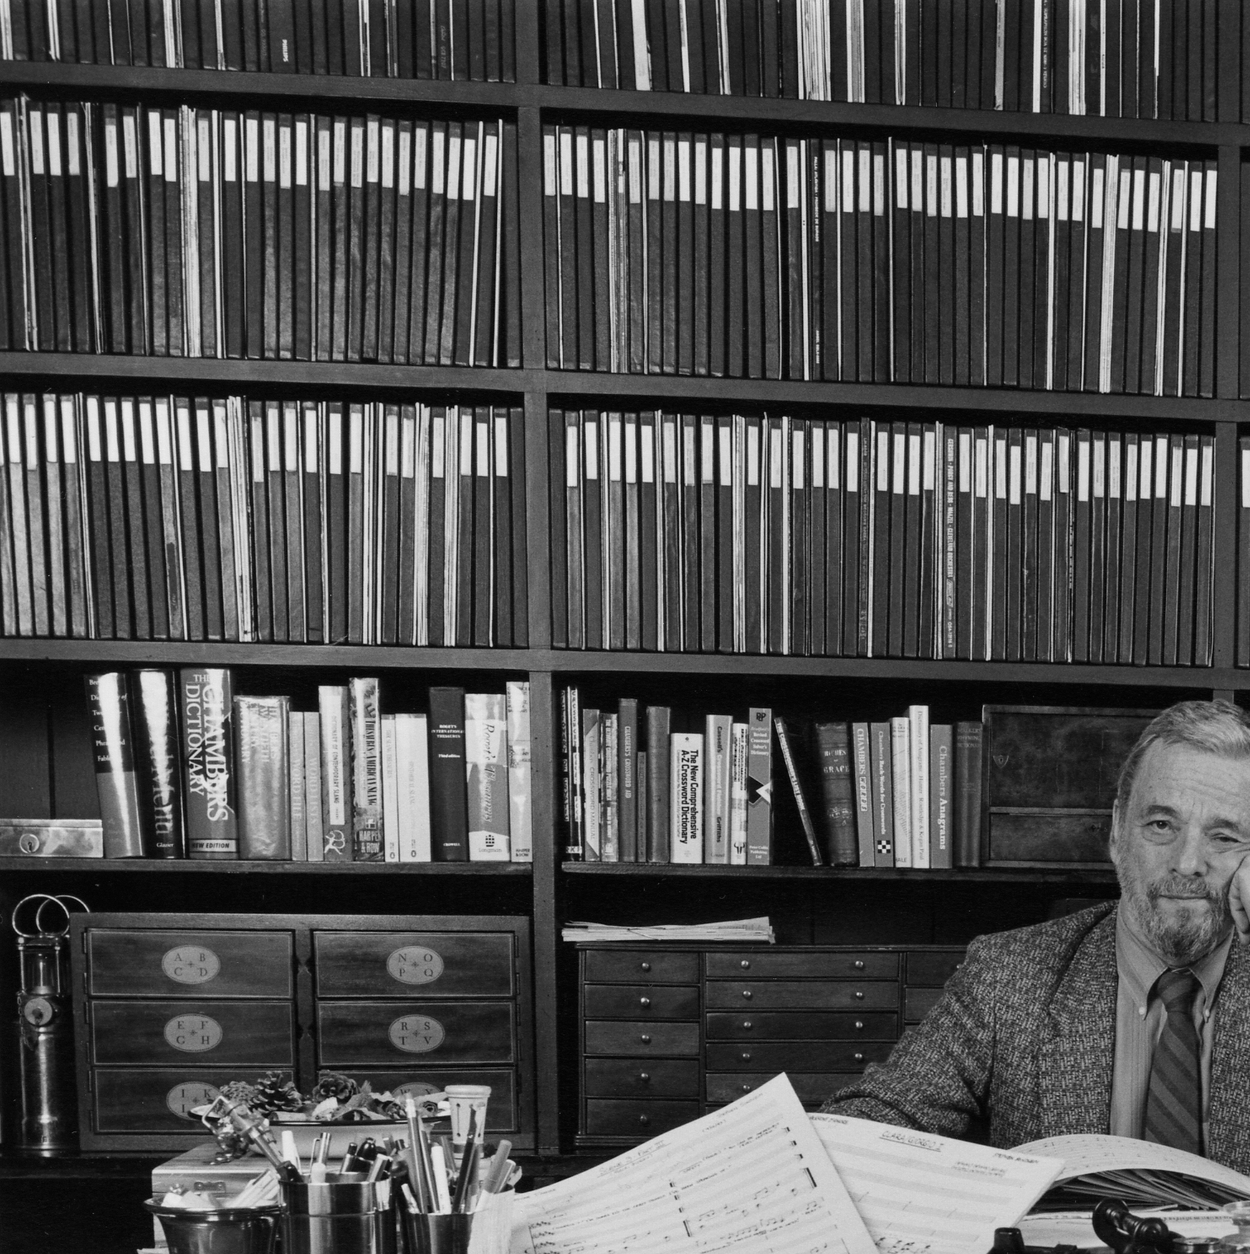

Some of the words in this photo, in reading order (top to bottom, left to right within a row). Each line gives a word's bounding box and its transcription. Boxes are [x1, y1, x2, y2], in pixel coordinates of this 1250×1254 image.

[184, 685, 205, 796] DICTIONARY
[201, 684, 229, 822] CHAMBERS
[483, 723, 496, 763] Roget's
[856, 728, 867, 775] CHAMBERS
[690, 750, 699, 763] The
[293, 758, 302, 789] WORD
[309, 757, 318, 791] WORD
[366, 755, 378, 786] AMERICAN
[624, 758, 632, 787] CROSSWORD
[690, 765, 699, 782] New
[938, 745, 948, 797] Chambers
[332, 788, 340, 804] SLANG
[367, 787, 378, 805] SLANG
[483, 765, 497, 823] Thesaurus
[624, 789, 632, 798] AID
[681, 764, 690, 805] Crossword
[151, 765, 175, 834] Menu
[293, 795, 302, 820] FILE
[310, 795, 318, 823] LISTS
[689, 783, 699, 839] Comprehensive
[917, 797, 925, 824] Routledge
[679, 806, 690, 845] Dictionary
[937, 798, 948, 850] Anagrams
[917, 831, 925, 848] Kegan
[174, 953, 183, 962] A
[199, 953, 206, 961] B
[398, 953, 407, 962] N
[424, 953, 433, 962] O
[174, 967, 183, 976] C
[198, 968, 208, 977] D
[399, 968, 406, 977] P
[424, 968, 434, 977] Q
[177, 1021, 185, 1030] E
[201, 1021, 209, 1030] F
[401, 1022, 408, 1031] R
[424, 1022, 430, 1030] S
[201, 1036, 210, 1045] H
[399, 1036, 407, 1045] T
[424, 1036, 432, 1045] V
[181, 1089, 186, 1098] I
[204, 1089, 211, 1098] K
